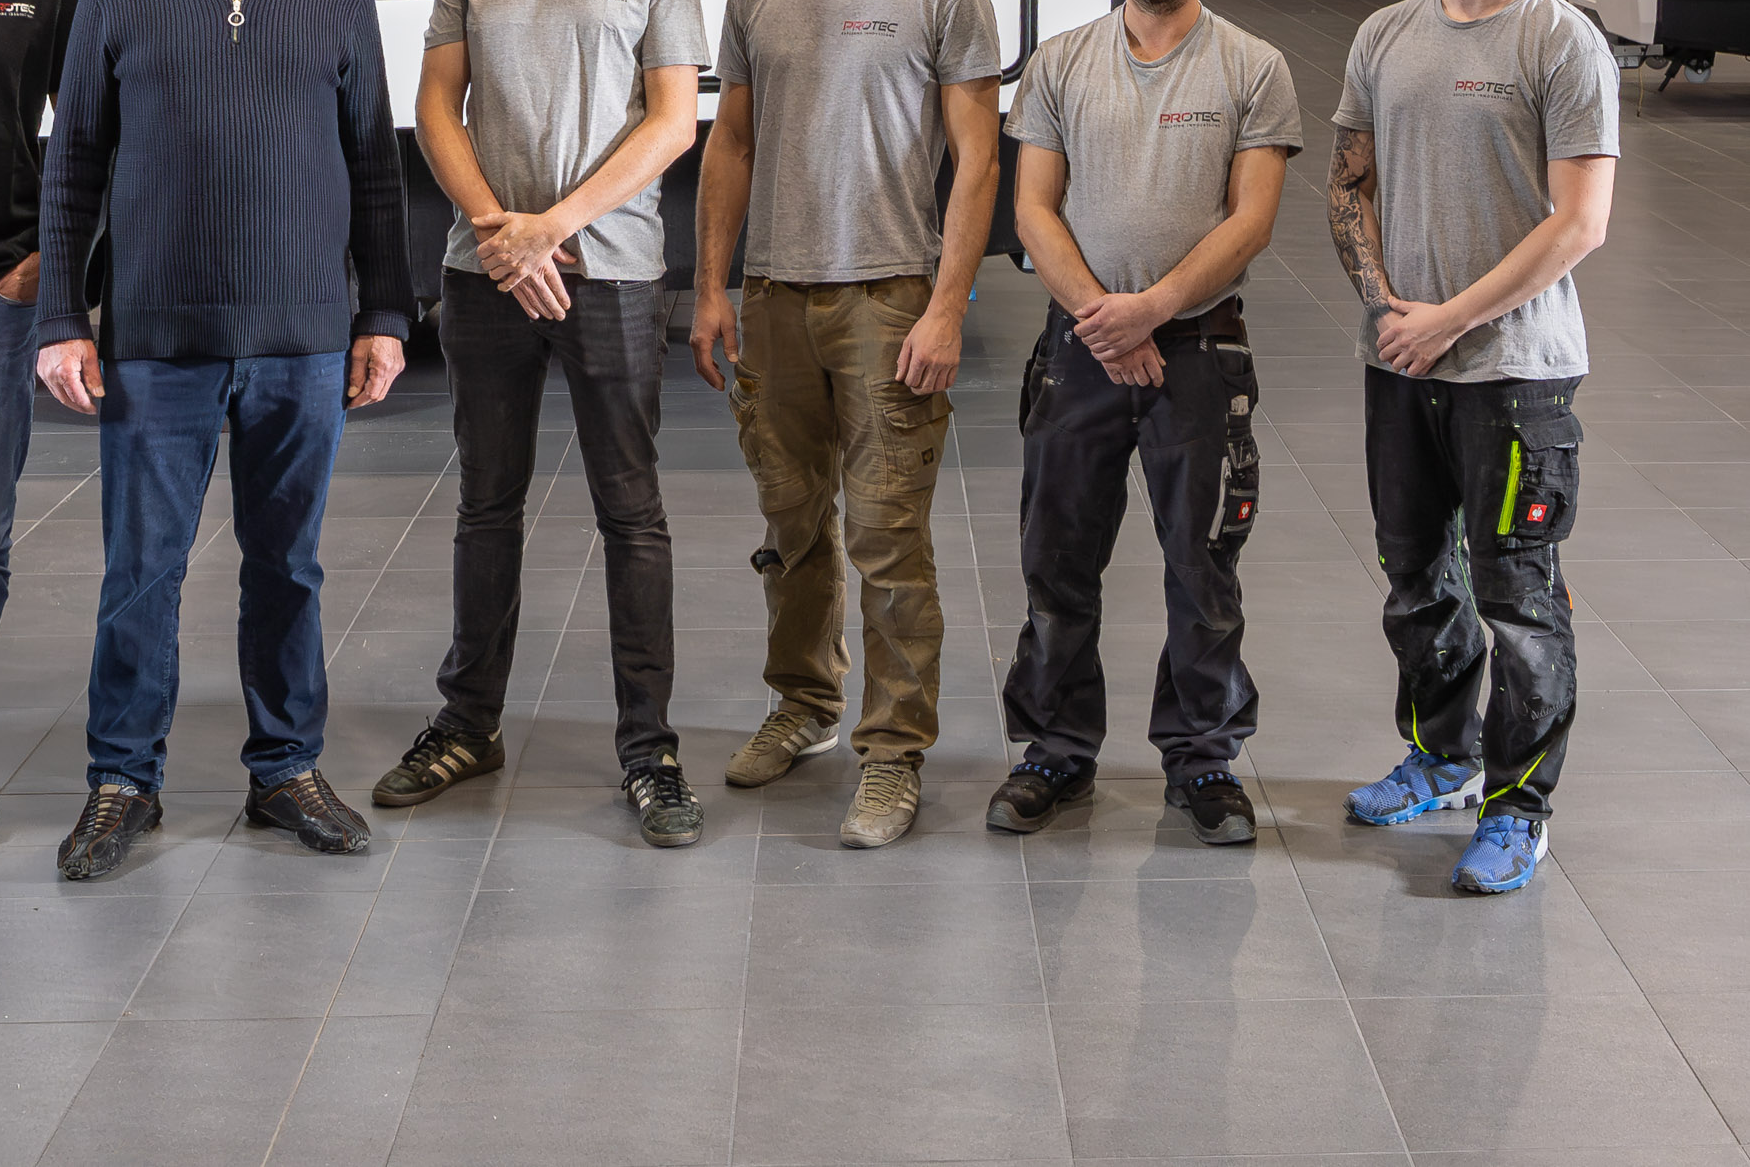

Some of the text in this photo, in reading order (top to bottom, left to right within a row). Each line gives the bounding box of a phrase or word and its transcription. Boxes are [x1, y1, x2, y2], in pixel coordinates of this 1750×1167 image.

[842, 20, 898, 33] PROTEC
[1455, 80, 1516, 96] PROTEC
[1159, 111, 1222, 124] PROTEC
